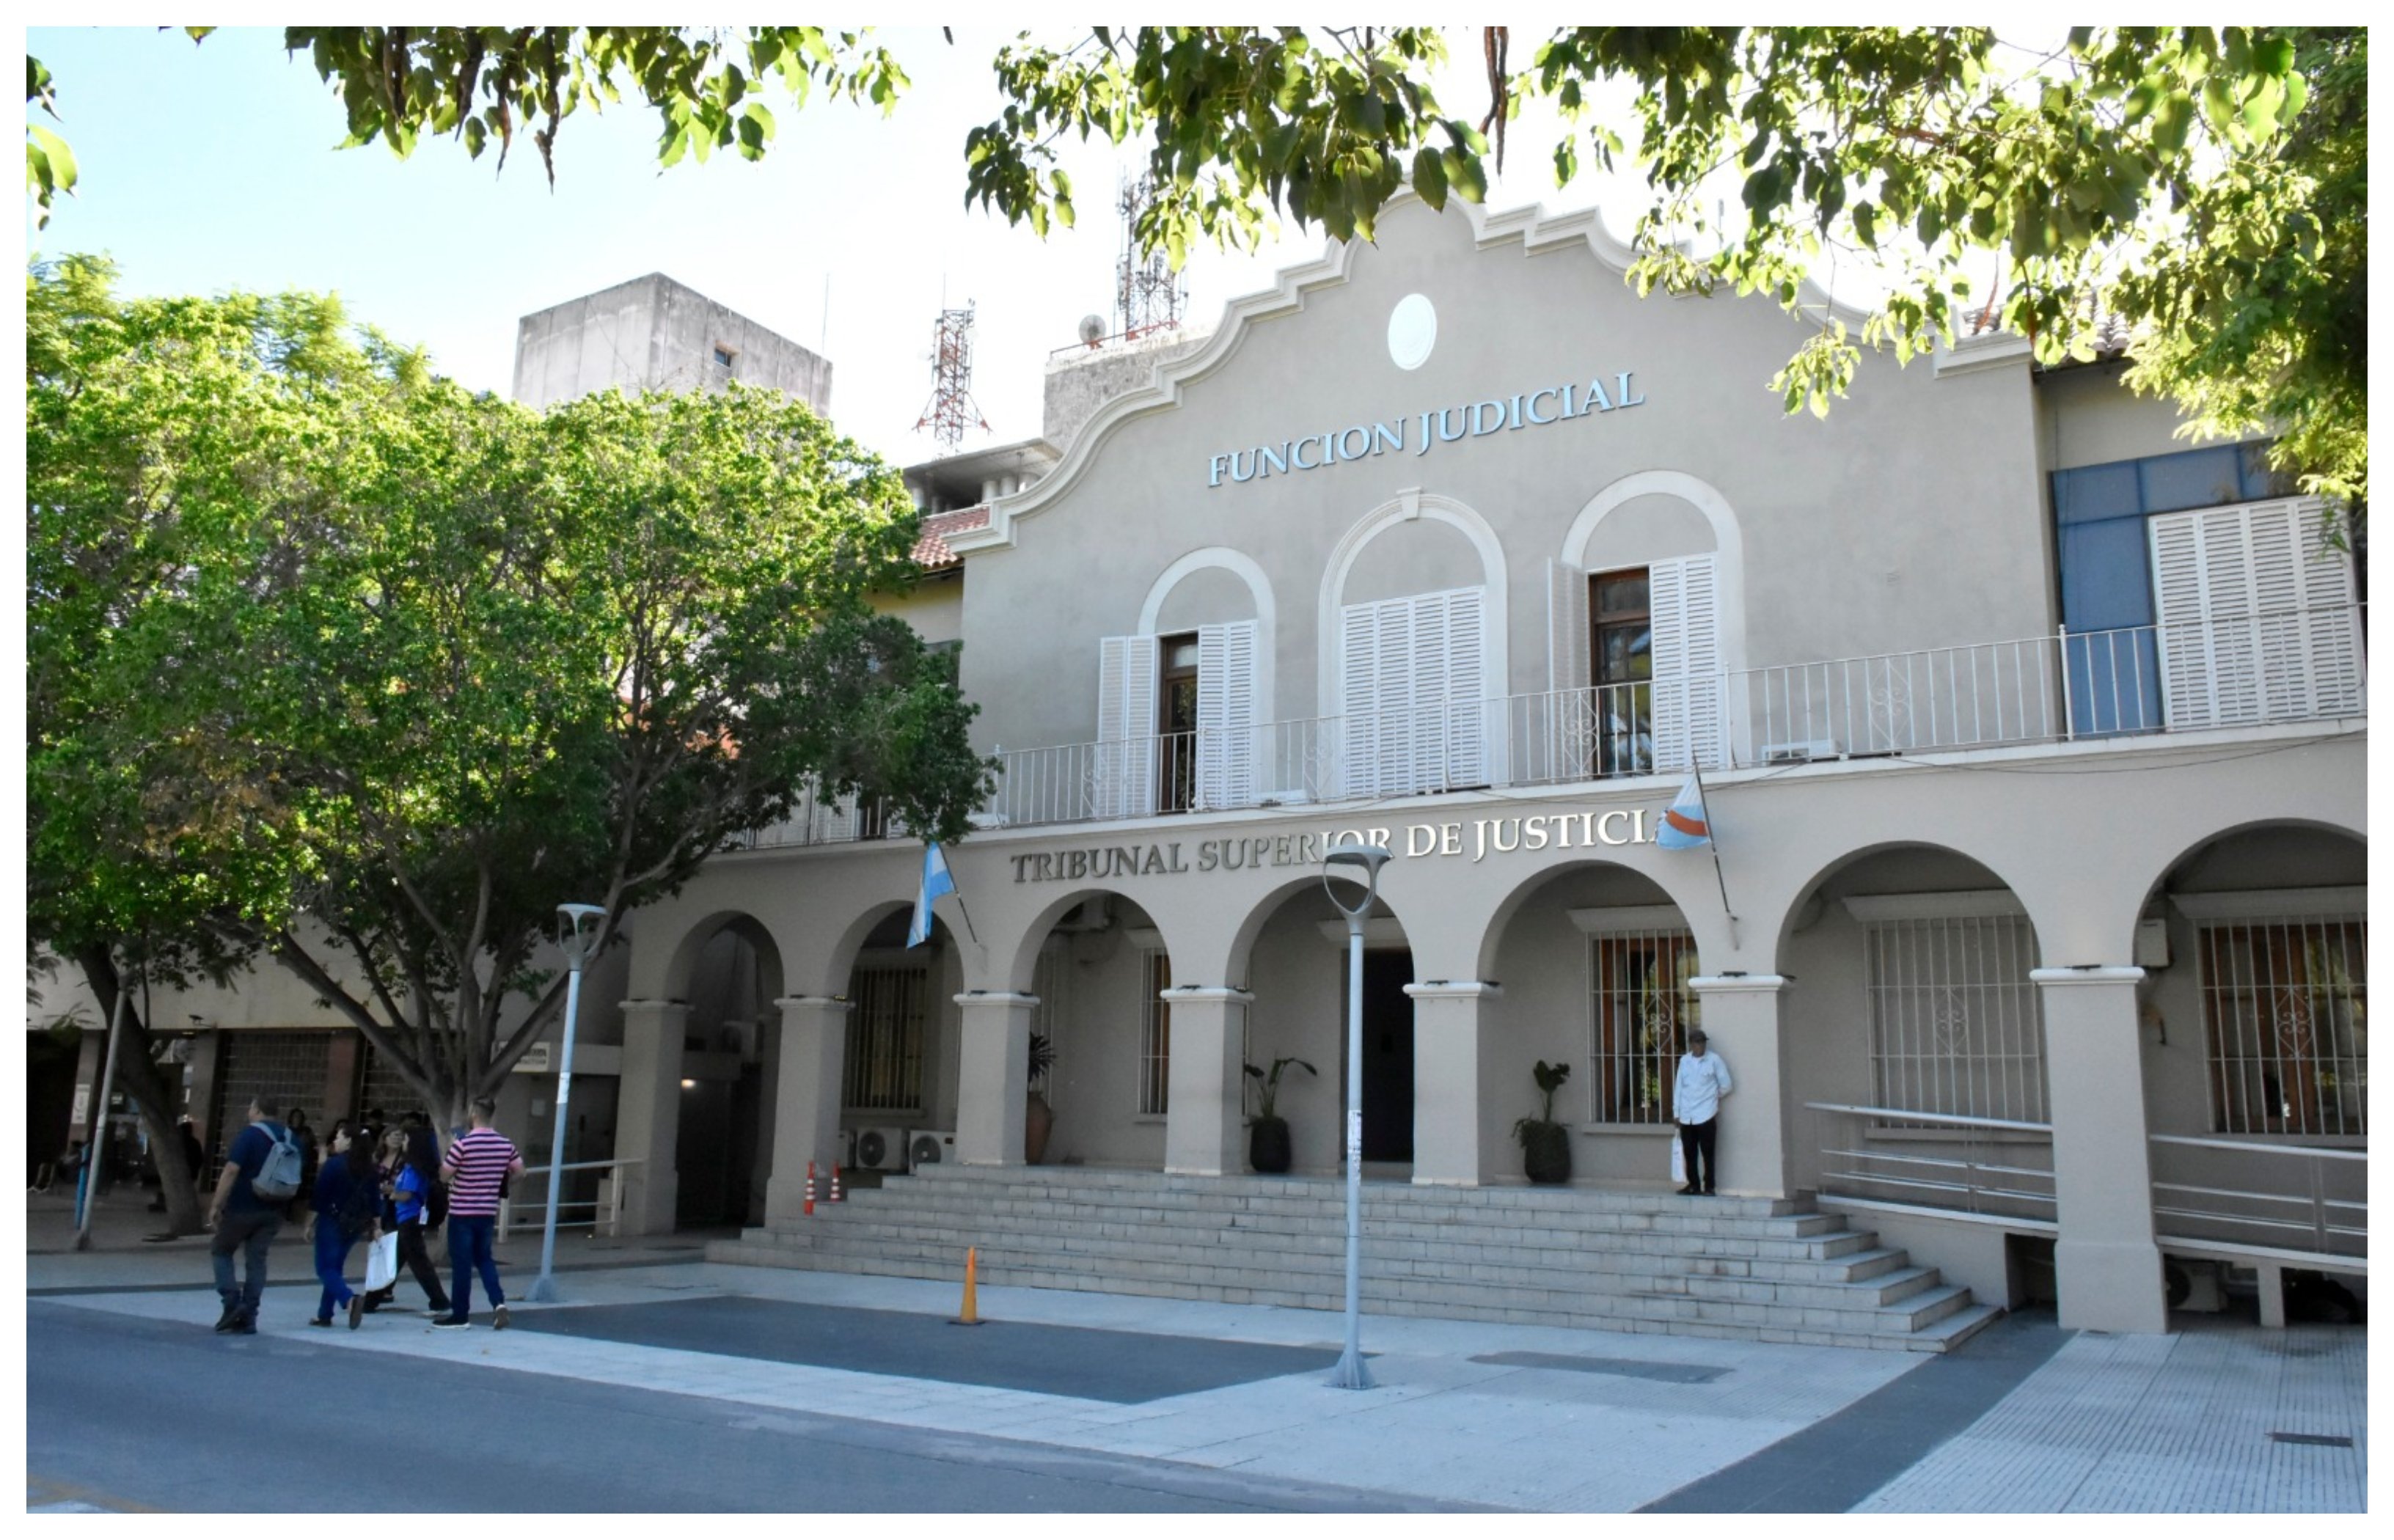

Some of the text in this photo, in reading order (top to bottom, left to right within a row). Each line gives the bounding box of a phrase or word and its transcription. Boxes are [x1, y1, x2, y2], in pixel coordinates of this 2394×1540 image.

[1208, 372, 1645, 488] FUNCION JUDICIAL
[1011, 843, 1188, 882] TRIBUNAL
[1405, 823, 1463, 857] DE
[1474, 809, 1657, 862] JUSTICI
